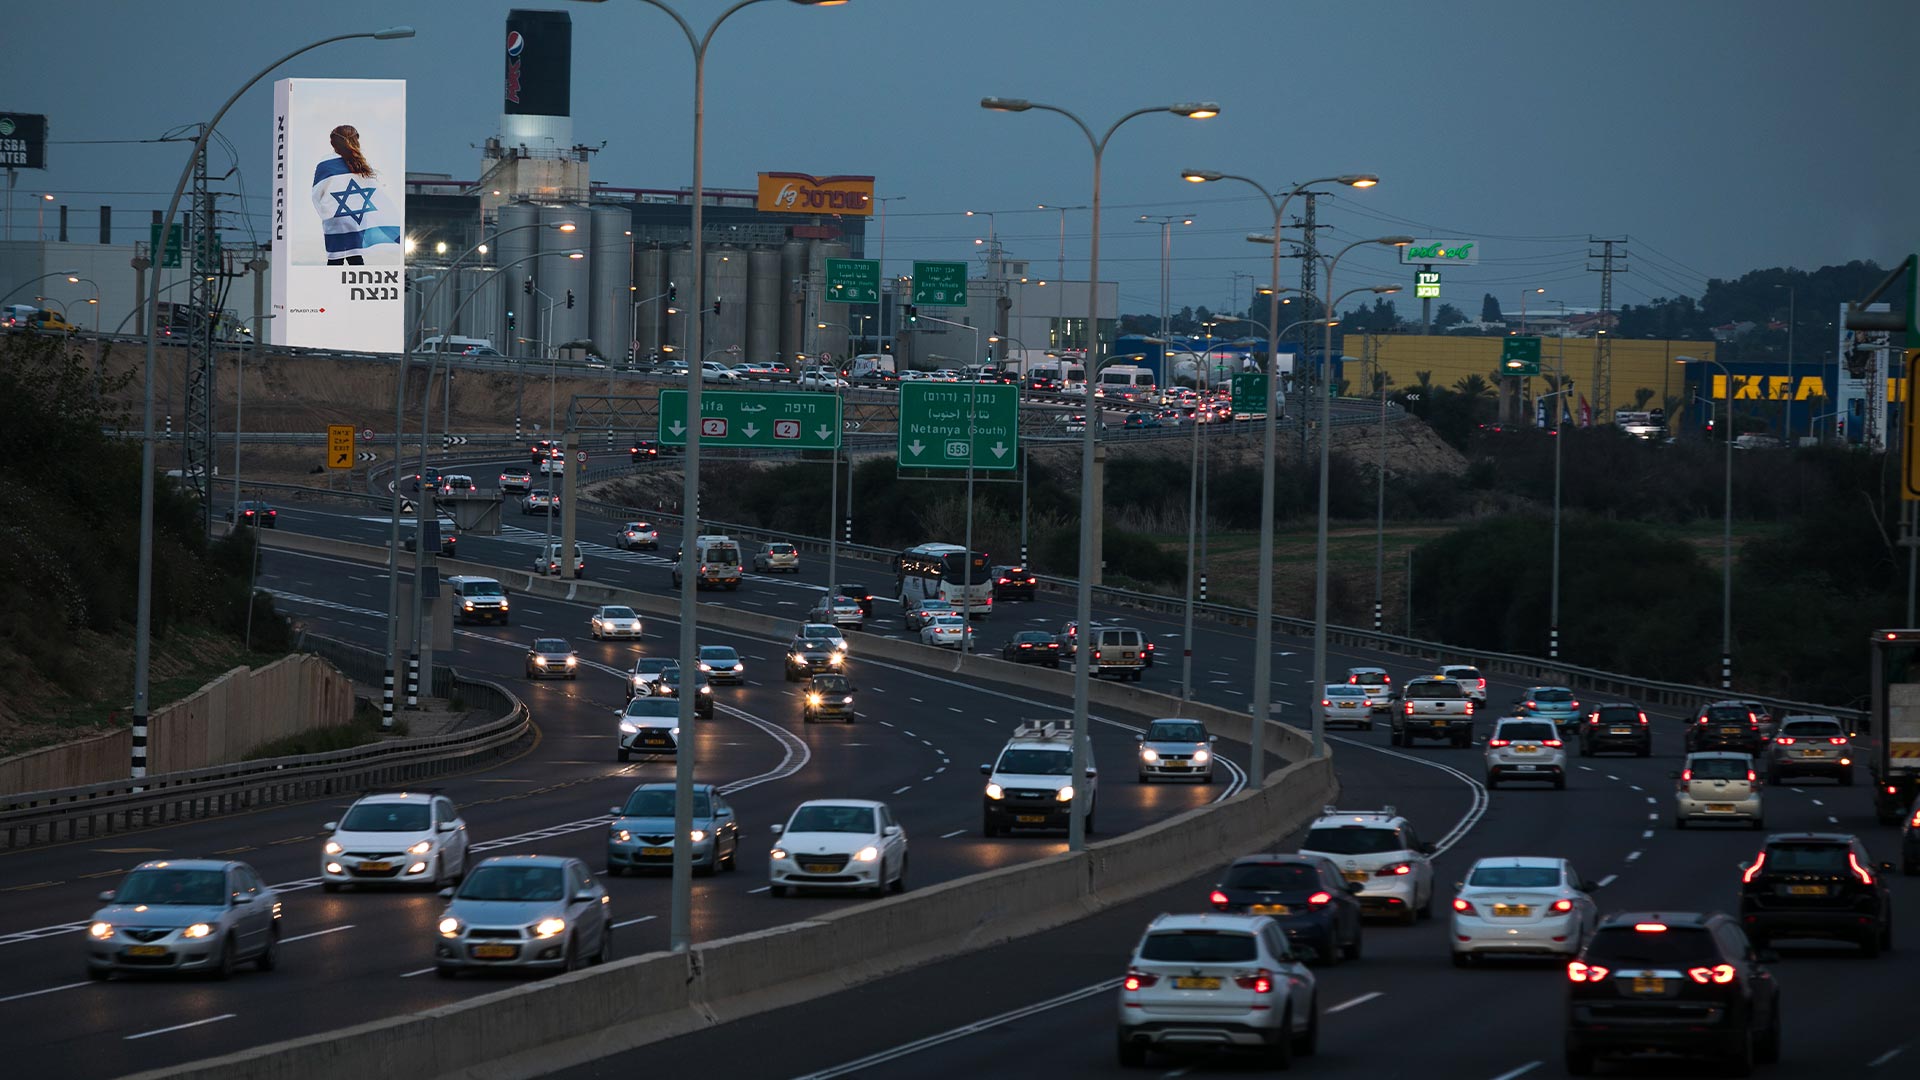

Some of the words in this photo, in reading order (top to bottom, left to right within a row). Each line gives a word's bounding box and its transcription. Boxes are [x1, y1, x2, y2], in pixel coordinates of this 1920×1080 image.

[799, 185, 868, 210] שופרסל
[342, 270, 399, 284] אנחנו
[1418, 273, 1439, 285] עדן
[351, 287, 398, 301] ננצח
[1712, 374, 1828, 401] IKEA
[923, 391, 957, 402] (דרום)
[963, 393, 996, 404] נתנה
[740, 401, 767, 415] حيفا
[784, 402, 816, 414] חיפה
[711, 422, 718, 432] 2
[784, 424, 791, 434] 2
[910, 423, 961, 436] Netanya
[967, 425, 1007, 437] (South)
[949, 445, 967, 454] 553
